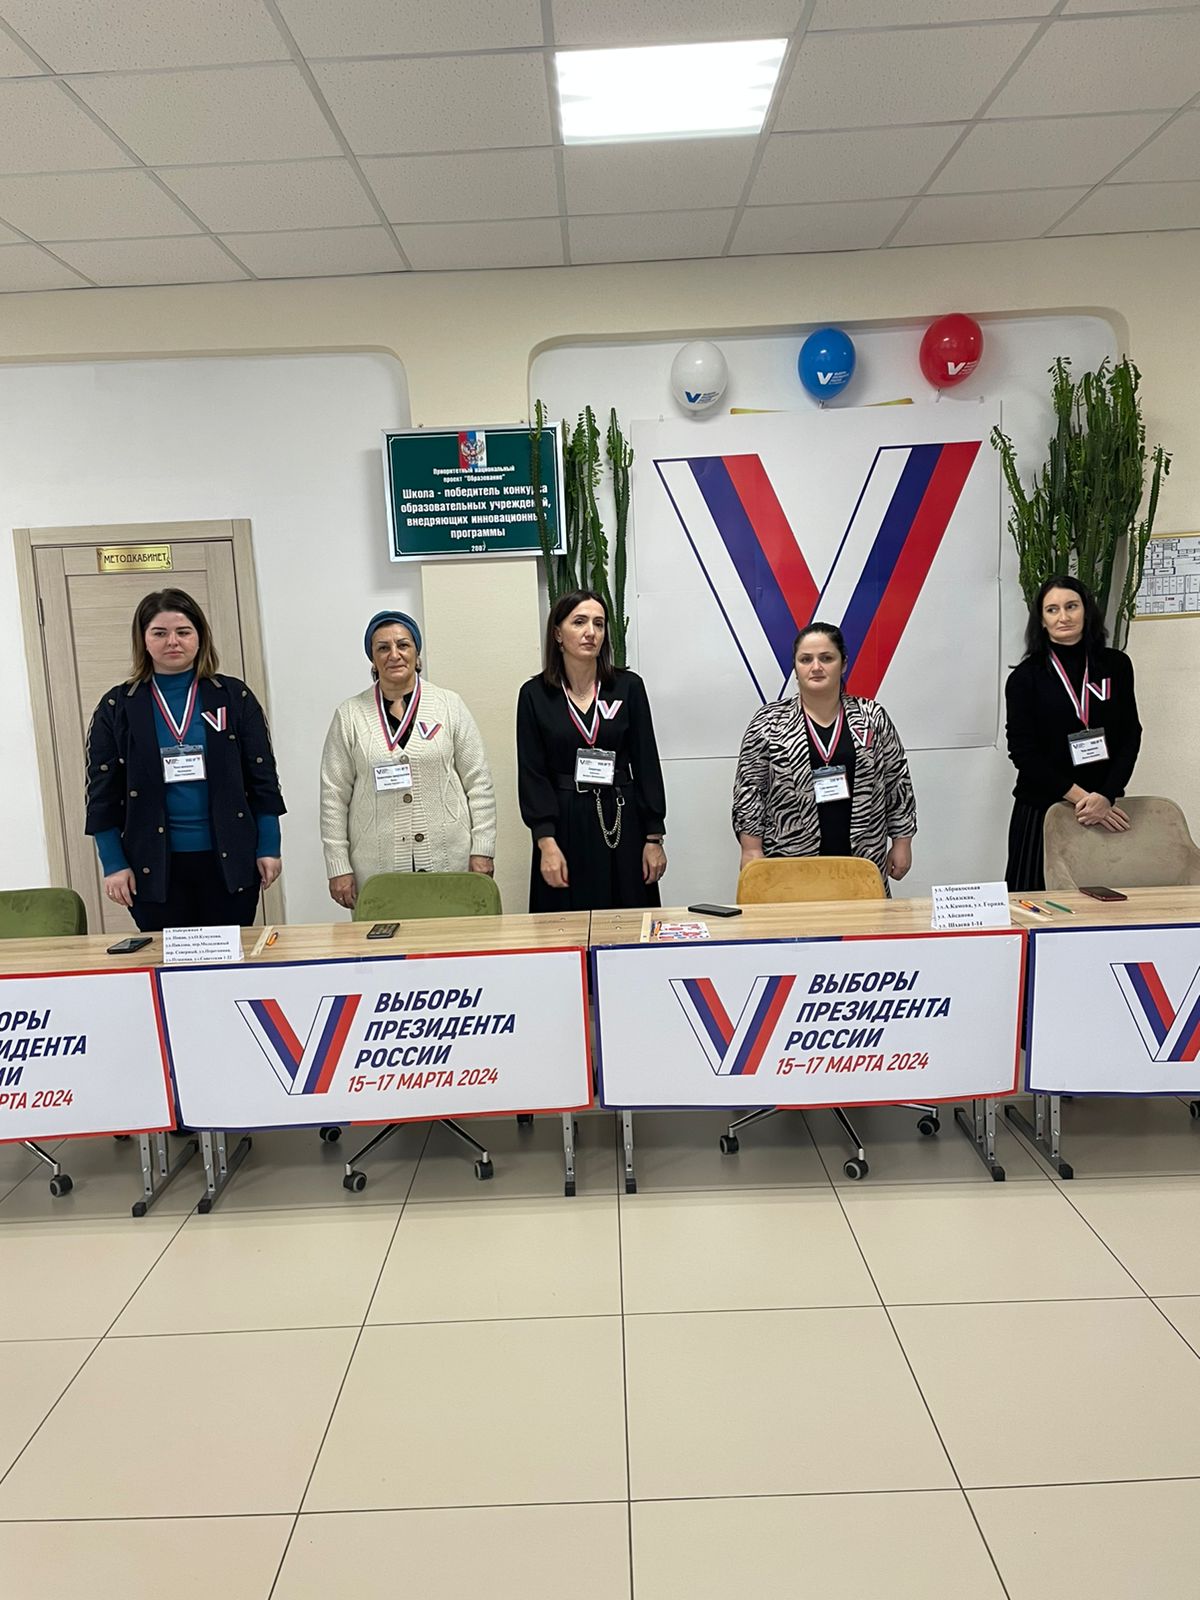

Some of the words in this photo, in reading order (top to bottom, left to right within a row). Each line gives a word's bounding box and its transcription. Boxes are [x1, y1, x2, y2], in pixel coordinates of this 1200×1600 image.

[402, 488, 434, 499] Школа
[444, 486, 500, 498] победитель
[400, 502, 486, 514] образовательных
[406, 516, 468, 527] внедряющих
[450, 528, 506, 540] программы
[104, 552, 166, 564] МЕТОДКАБИНЕТ
[808, 971, 920, 994] ВЫБОРЫ
[374, 988, 482, 1014] ВЫБОРЫ
[796, 997, 951, 1023] ПРЕЗИДЕНТА
[364, 1014, 516, 1042] ПРЕЗИДЕНТА
[784, 1028, 884, 1051] РОССИИ
[354, 1045, 452, 1069] РОССИИ
[825, 1054, 884, 1073] МАРТА
[886, 1052, 929, 1071] 2024
[396, 1070, 454, 1090] МАРТА
[457, 1068, 498, 1086] 2024
[31, 1089, 74, 1108] 2024
